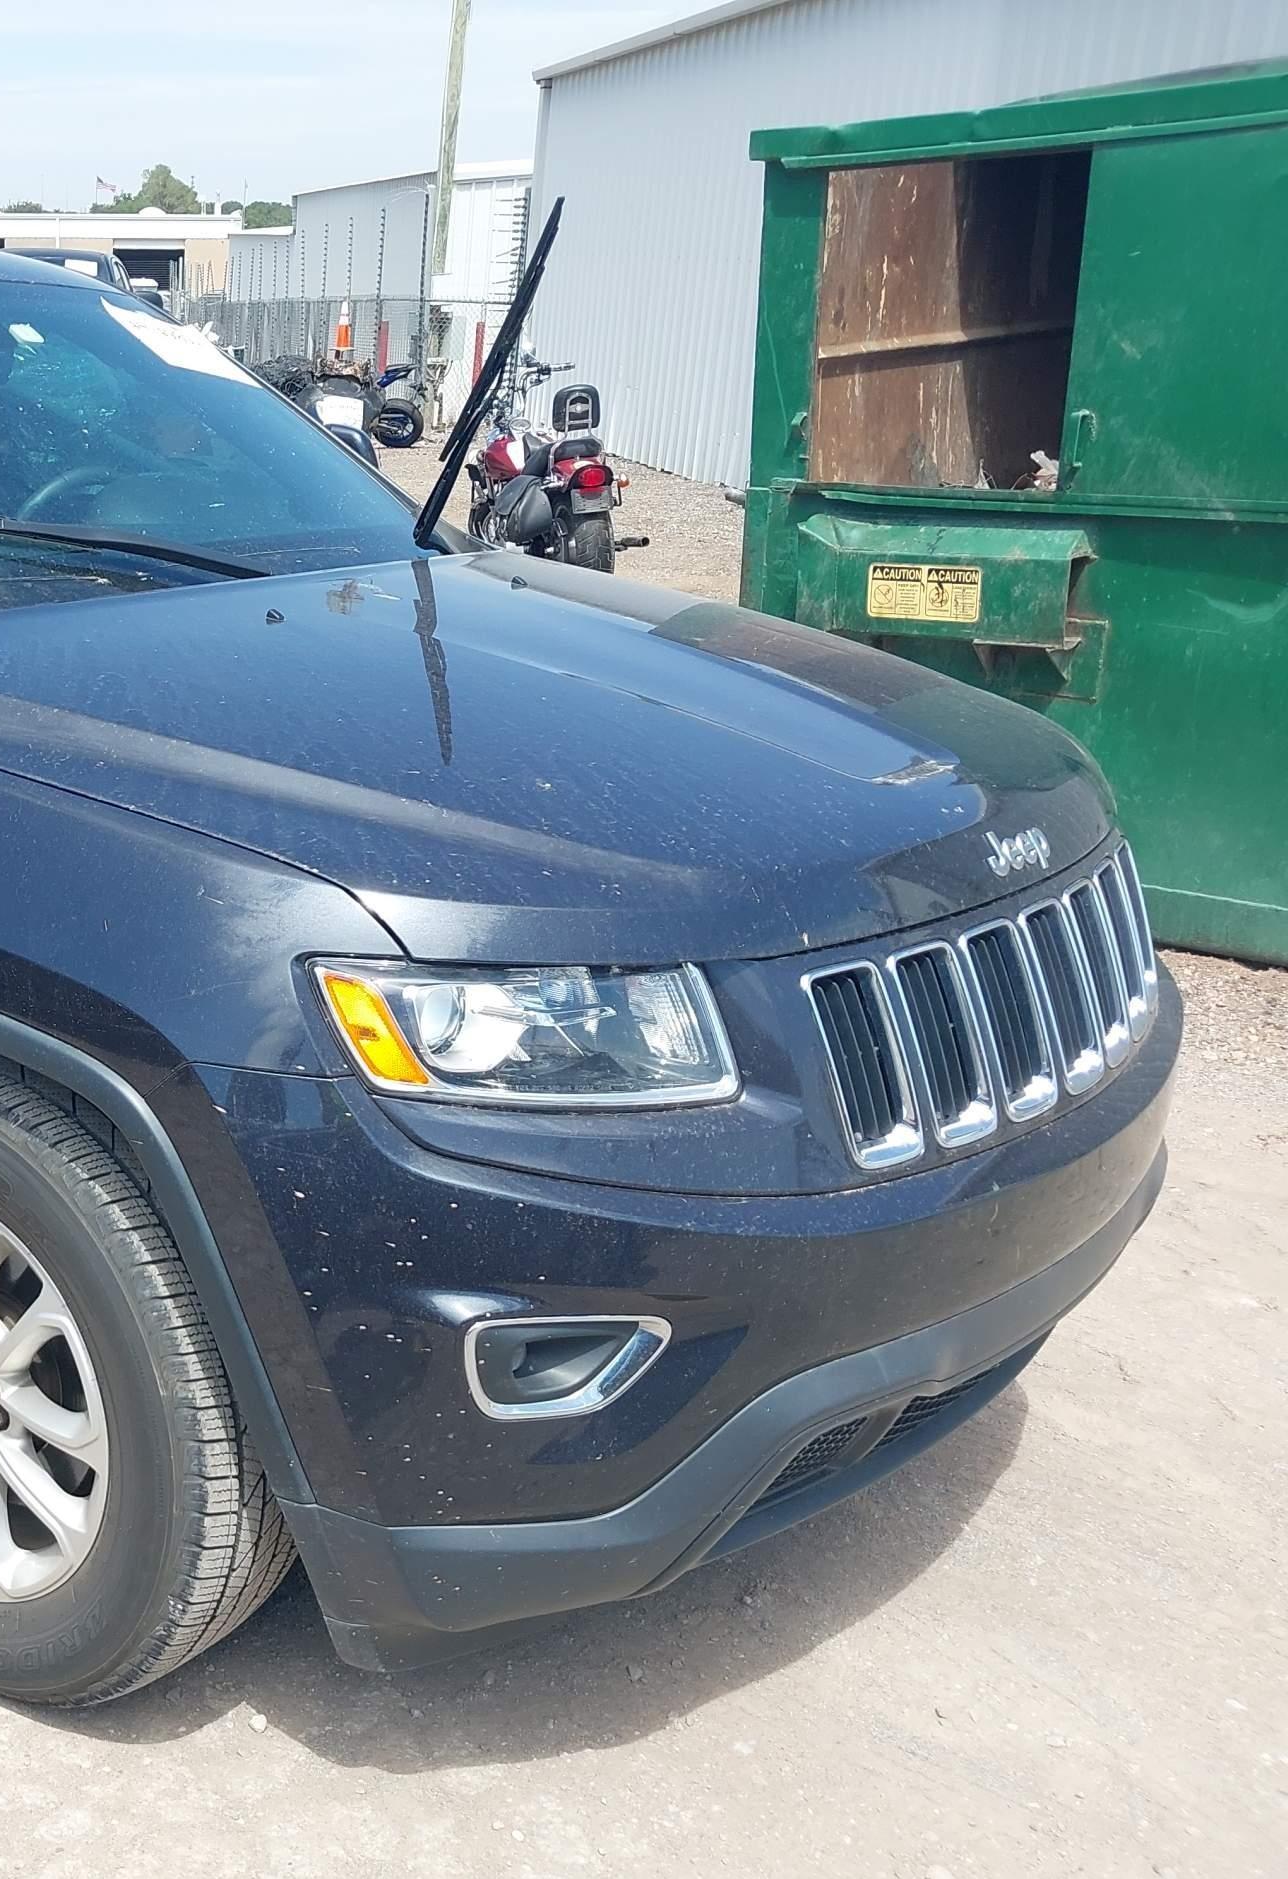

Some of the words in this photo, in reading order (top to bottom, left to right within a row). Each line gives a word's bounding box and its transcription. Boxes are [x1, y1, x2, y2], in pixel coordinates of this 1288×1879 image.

[883, 568, 922, 580] CAUTION
[938, 570, 978, 583] CAUTION
[983, 826, 1051, 877] Jeep
